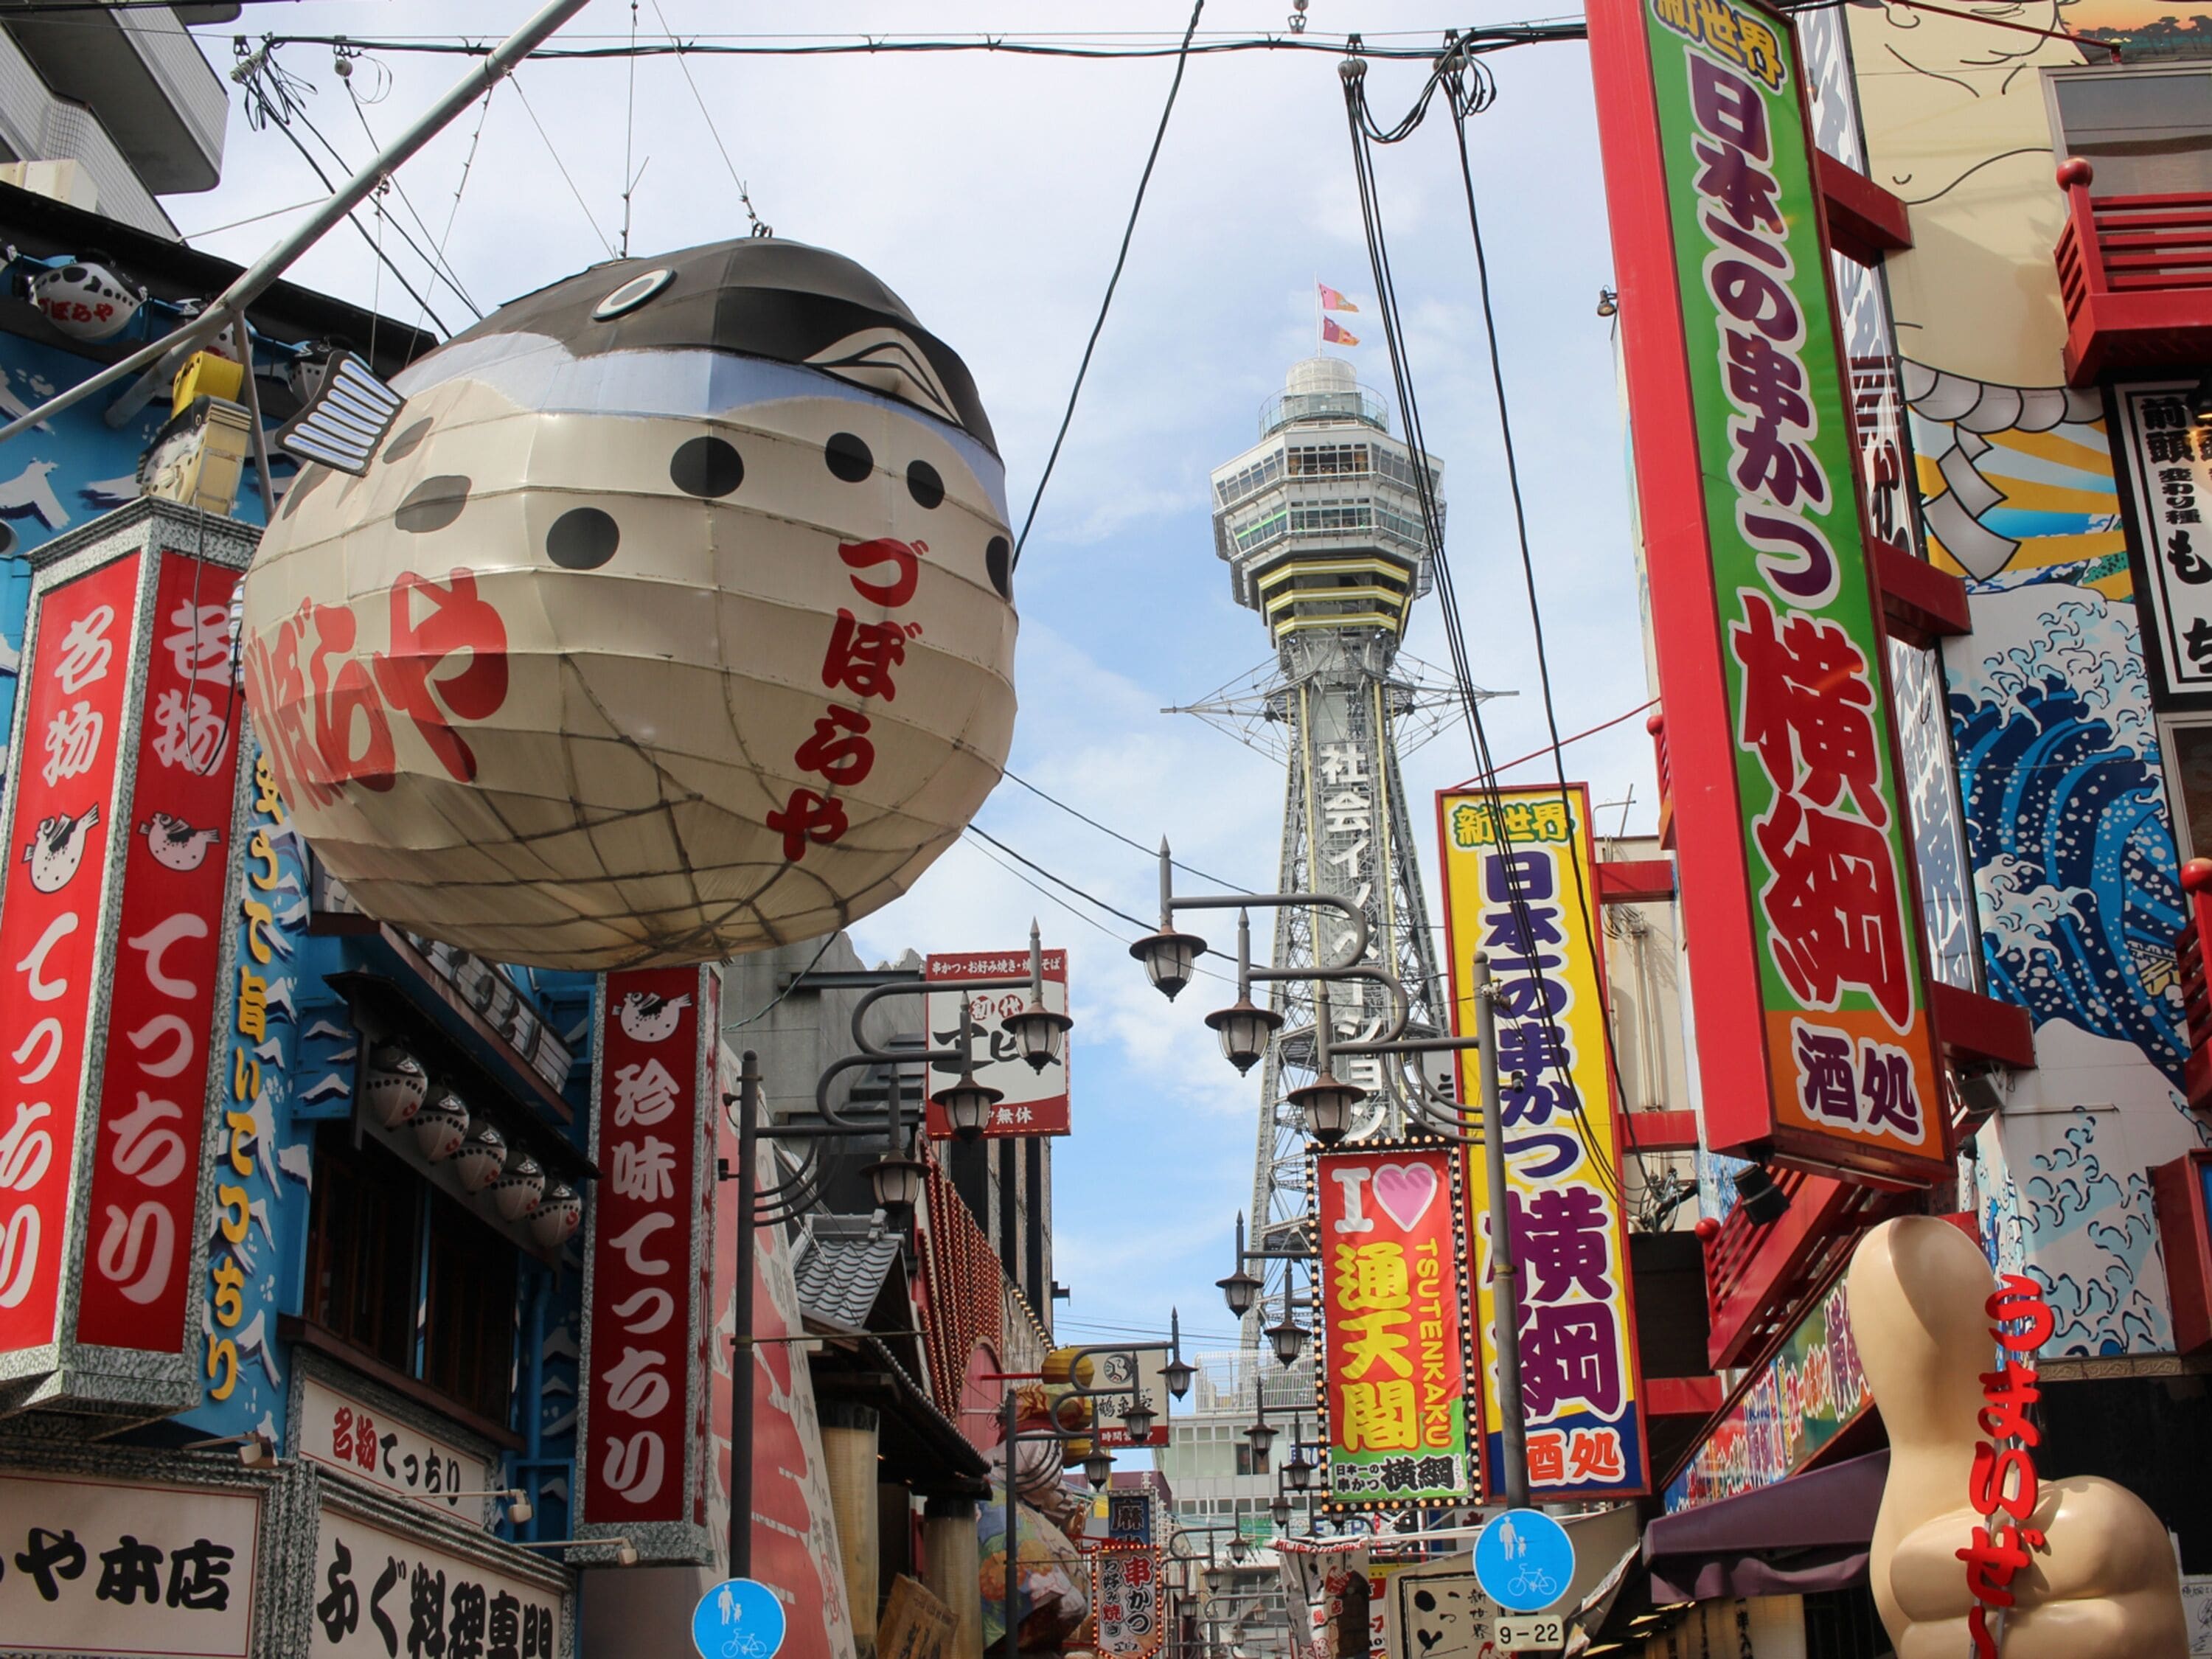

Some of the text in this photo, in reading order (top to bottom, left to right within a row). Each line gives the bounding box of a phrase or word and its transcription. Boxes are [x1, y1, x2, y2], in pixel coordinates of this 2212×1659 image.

[1691, 55, 1833, 597] 日本一の串かつ
[766, 538, 929, 862] づぼらや
[1453, 803, 1573, 846] 新世界
[1735, 593, 1910, 1029] 横綱
[932, 956, 1061, 975] 串かつ・お好み焼き・焼そば
[1482, 849, 1581, 1180] 日本一の串かつ
[98, 911, 209, 1305] てっちり
[1798, 1026, 1918, 1136] 酒処
[602, 1057, 681, 1504] 珍味てっちり
[1333, 1241, 1419, 1450] 通天閣
[1414, 1237, 1452, 1447] TSUTENKAKU
[1336, 1464, 1380, 1475] 日本一の
[1338, 1478, 1380, 1492] 串かつ
[1380, 1455, 1455, 1492] 横綱
[0, 1526, 235, 1611] や本店
[1122, 1556, 1152, 1635] 串かつ
